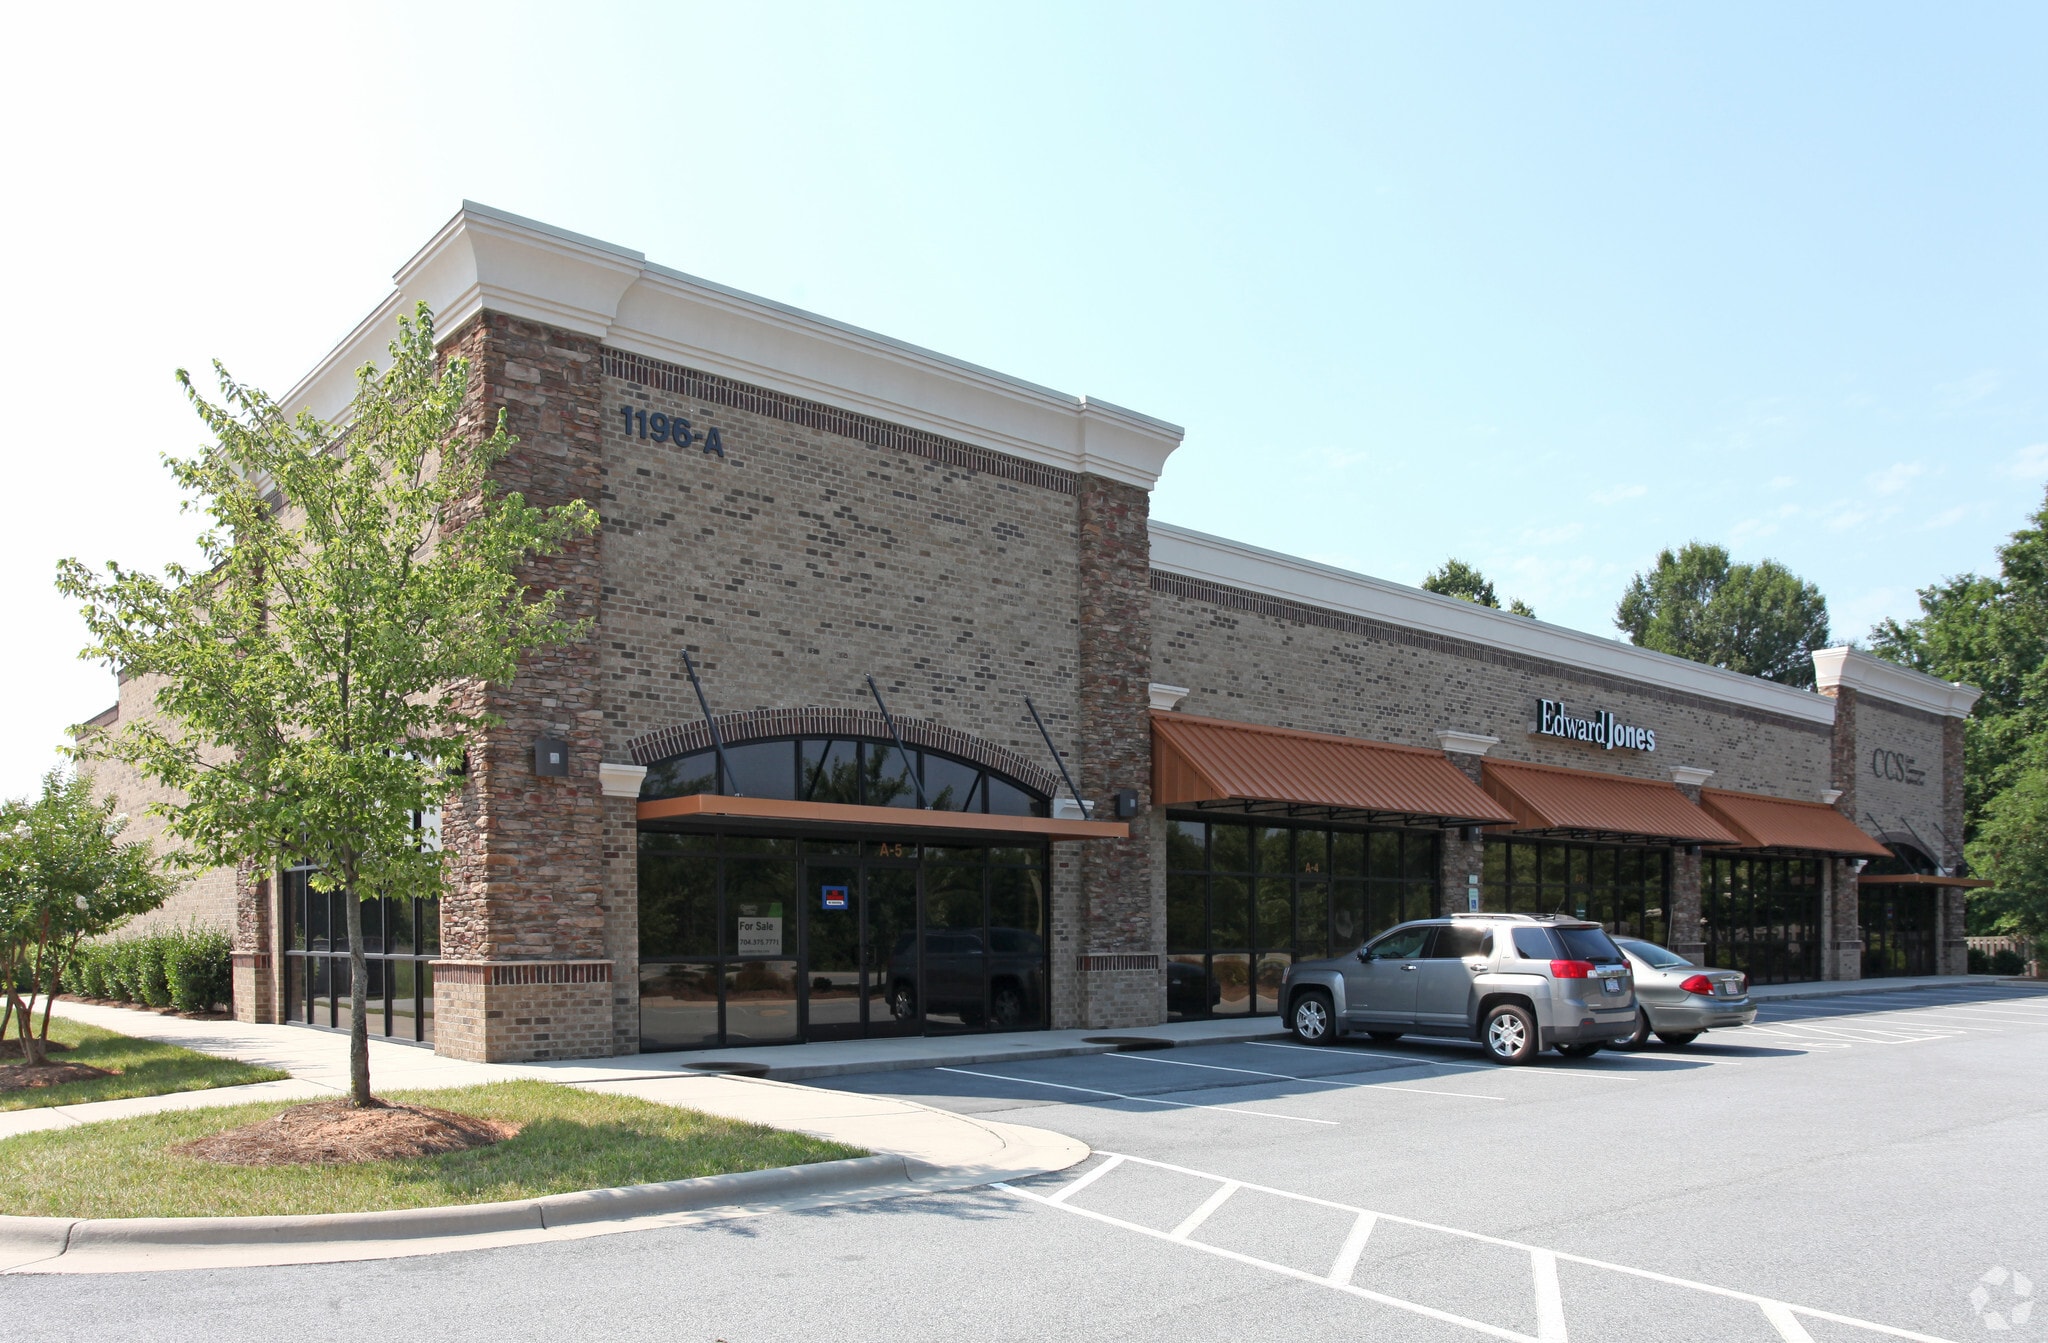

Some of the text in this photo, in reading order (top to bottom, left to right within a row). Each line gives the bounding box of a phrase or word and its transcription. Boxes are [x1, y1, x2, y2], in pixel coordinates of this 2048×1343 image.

[620, 405, 724, 457] 1196-A
[1538, 698, 1656, 751] Edward Jones
[1873, 748, 1904, 782] CCS
[879, 842, 903, 858] A-5
[739, 921, 774, 931] For Sale
